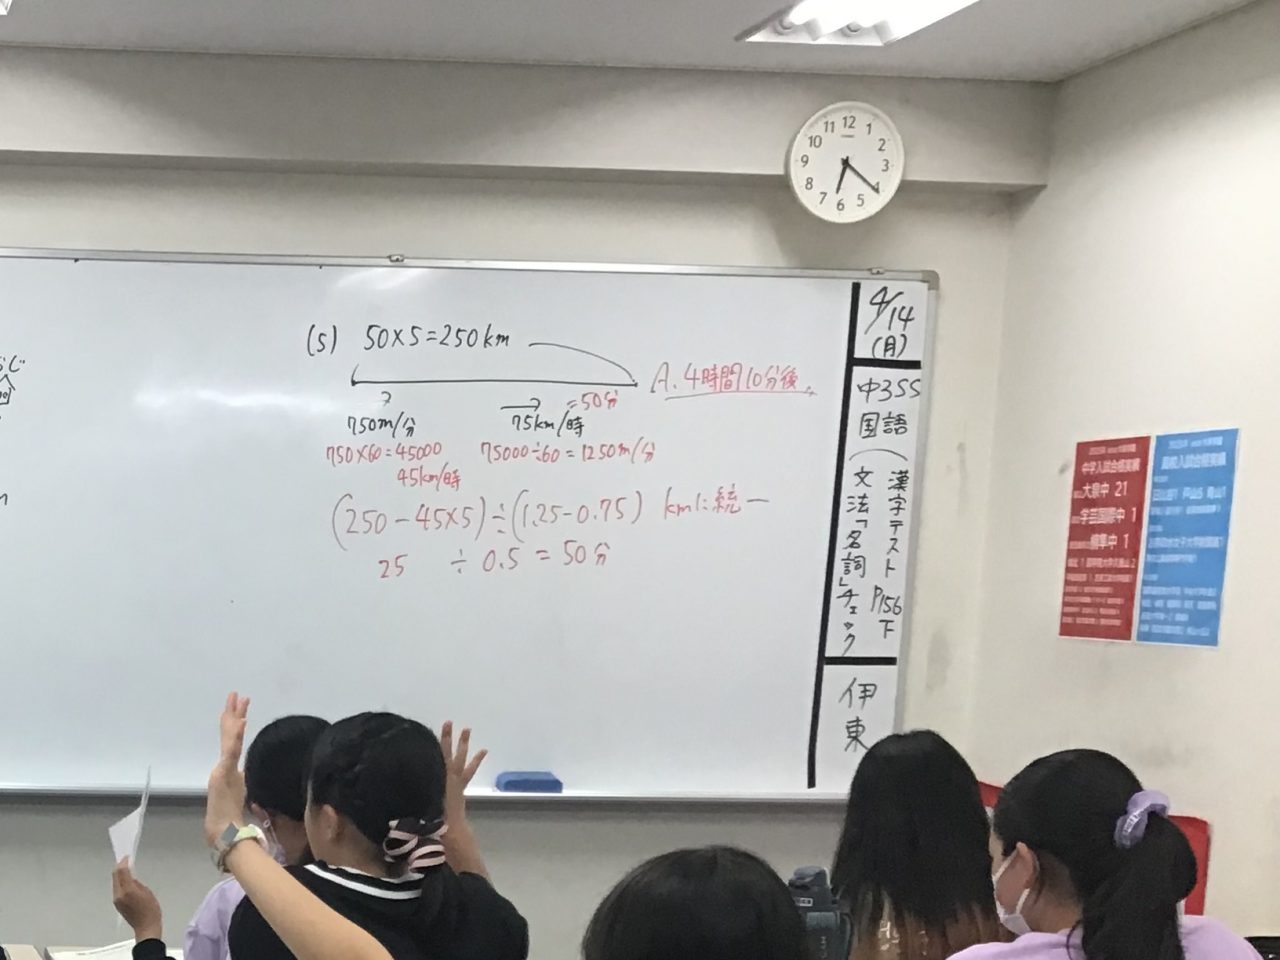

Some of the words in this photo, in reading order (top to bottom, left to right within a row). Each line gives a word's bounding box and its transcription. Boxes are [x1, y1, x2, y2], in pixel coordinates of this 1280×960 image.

[823, 120, 835, 133] 11
[842, 115, 856, 129] 12
[866, 122, 872, 135] 1
[808, 134, 822, 148] 10
[877, 138, 886, 152] 2
[800, 154, 809, 168] 9
[881, 158, 889, 172] 3
[804, 177, 813, 190] 8
[819, 191, 827, 205] 7
[836, 198, 845, 211] 6
[856, 193, 865, 207] 5
[864, 286, 915, 335] 4/14
[872, 334, 908, 359] (月)
[859, 411, 908, 439] 国語
[838, 677, 878, 752] 伊東
